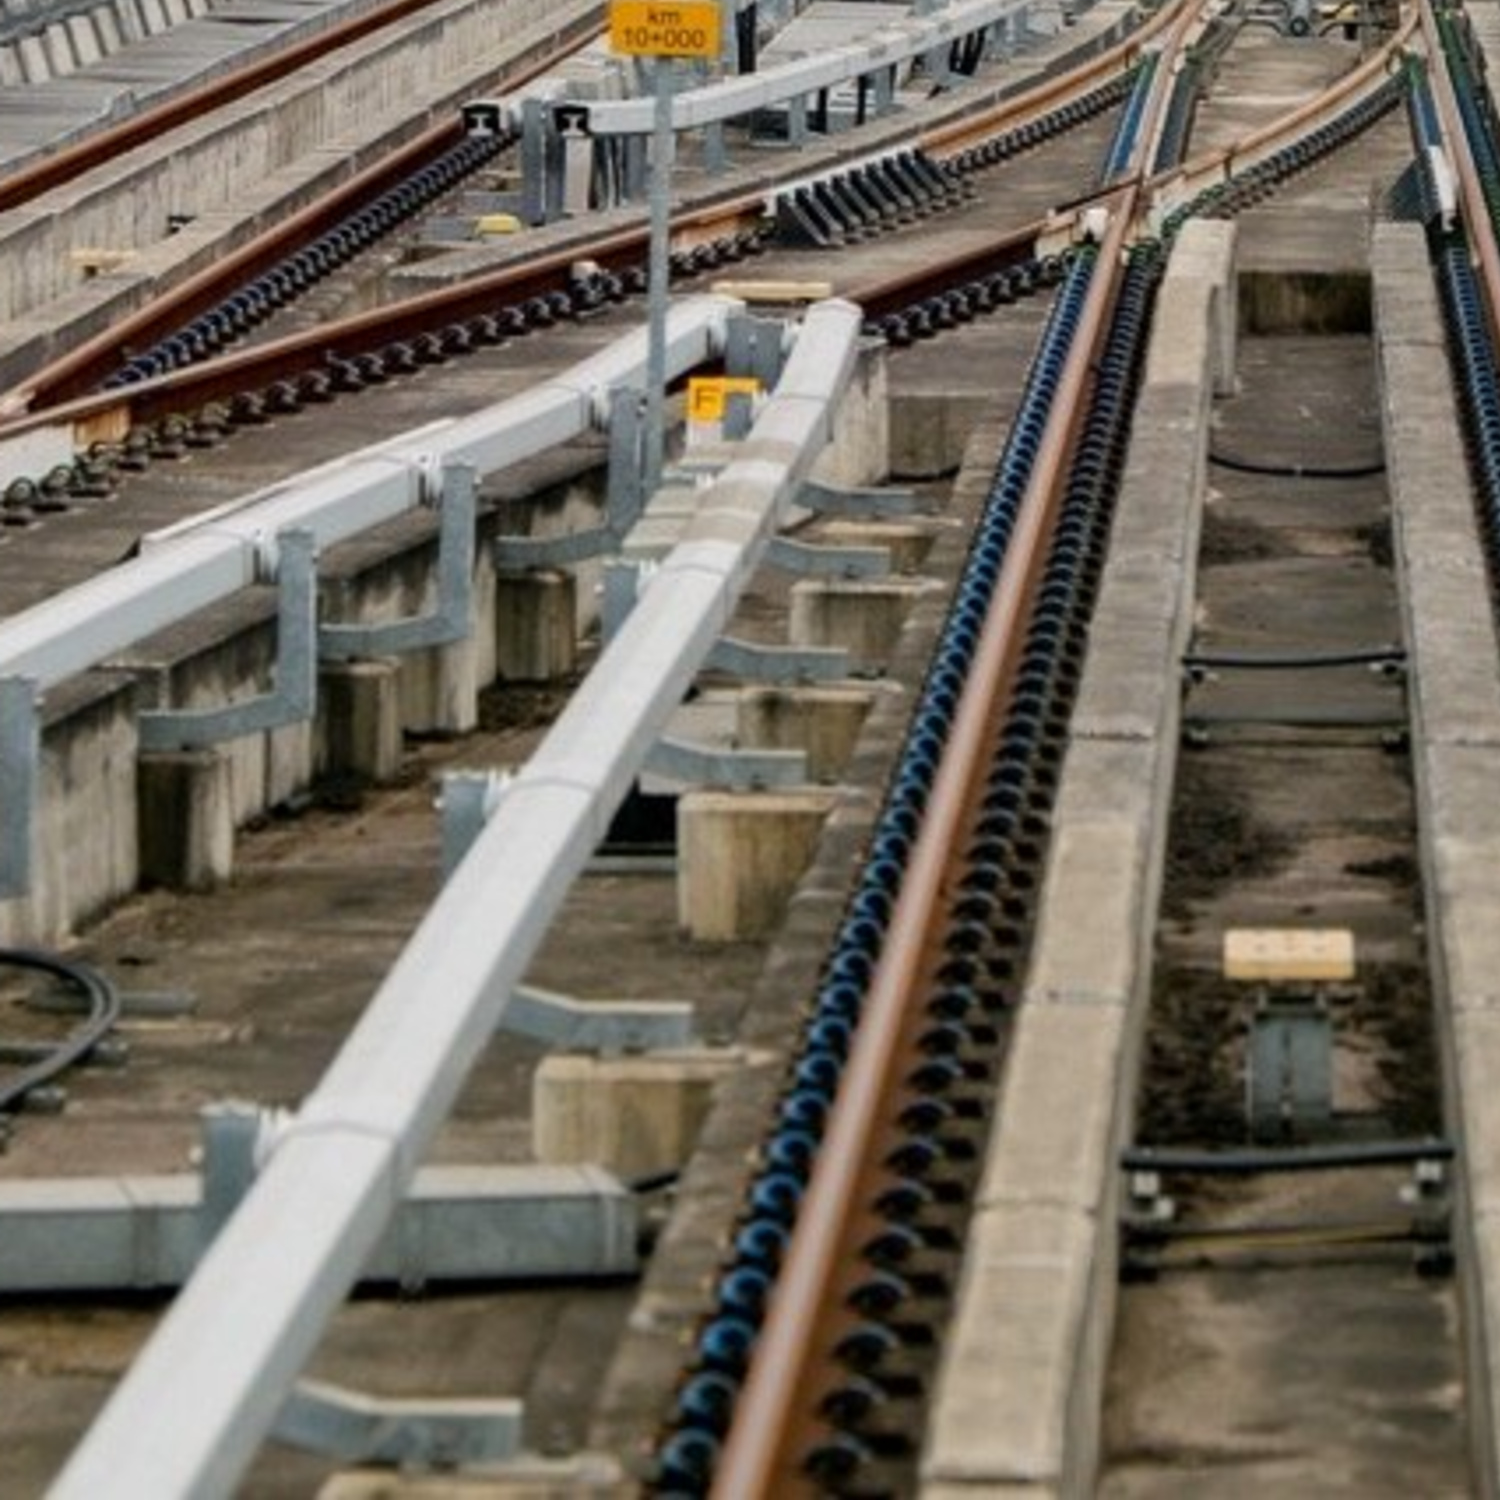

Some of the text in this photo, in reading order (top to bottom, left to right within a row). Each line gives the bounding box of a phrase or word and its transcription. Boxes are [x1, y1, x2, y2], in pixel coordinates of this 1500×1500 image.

[646, 6, 681, 23] km
[623, 27, 705, 48] 10+000
[695, 385, 719, 411] F
